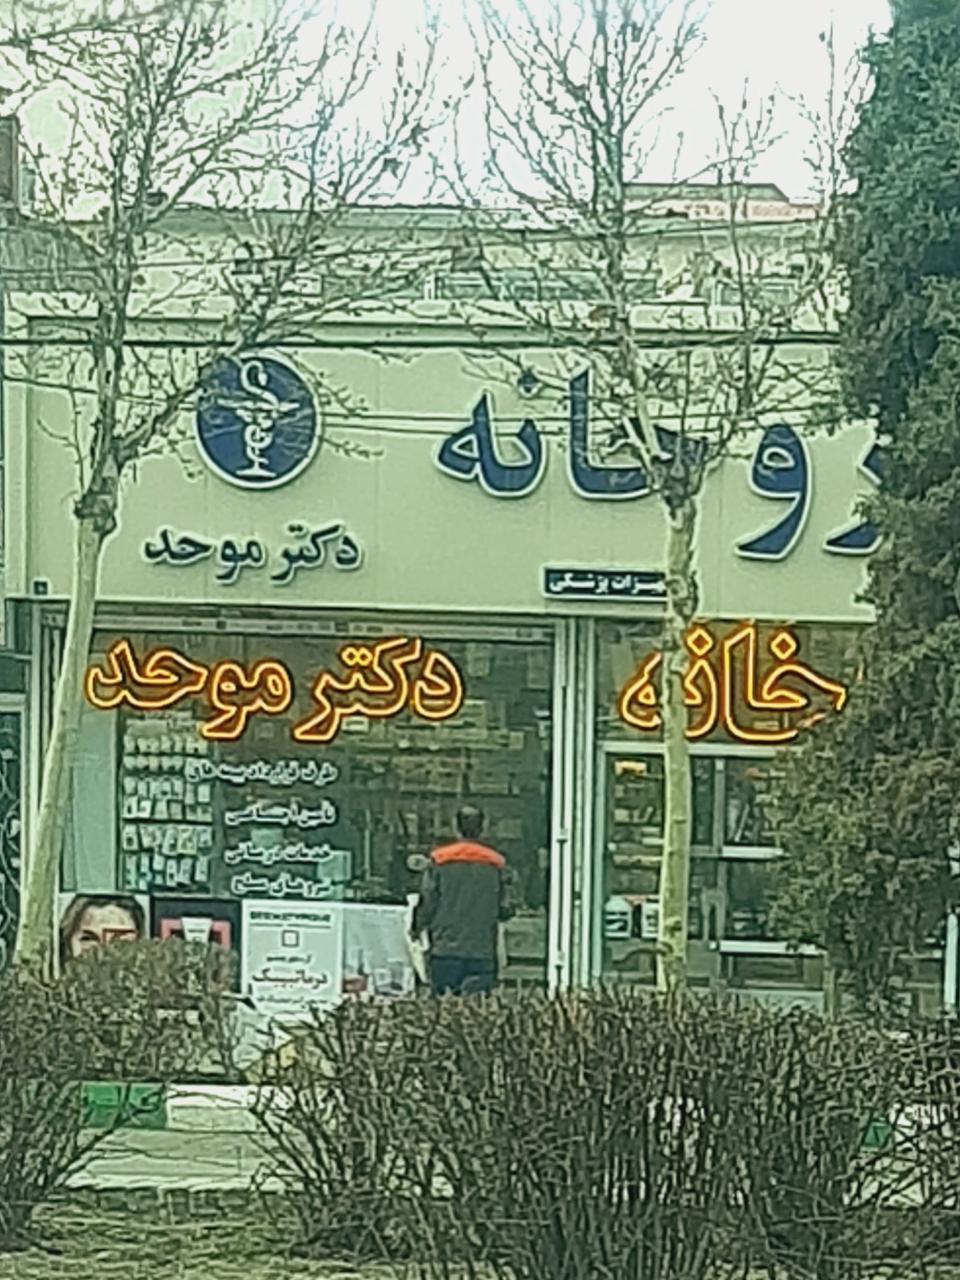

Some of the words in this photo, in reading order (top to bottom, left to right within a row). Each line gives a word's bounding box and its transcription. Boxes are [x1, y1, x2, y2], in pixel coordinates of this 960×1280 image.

[144, 527, 264, 583] موحد
[270, 523, 361, 583] دکتر
[550, 573, 609, 593] پزشکی
[85, 641, 293, 741] موحد
[294, 634, 464, 741] دکتر
